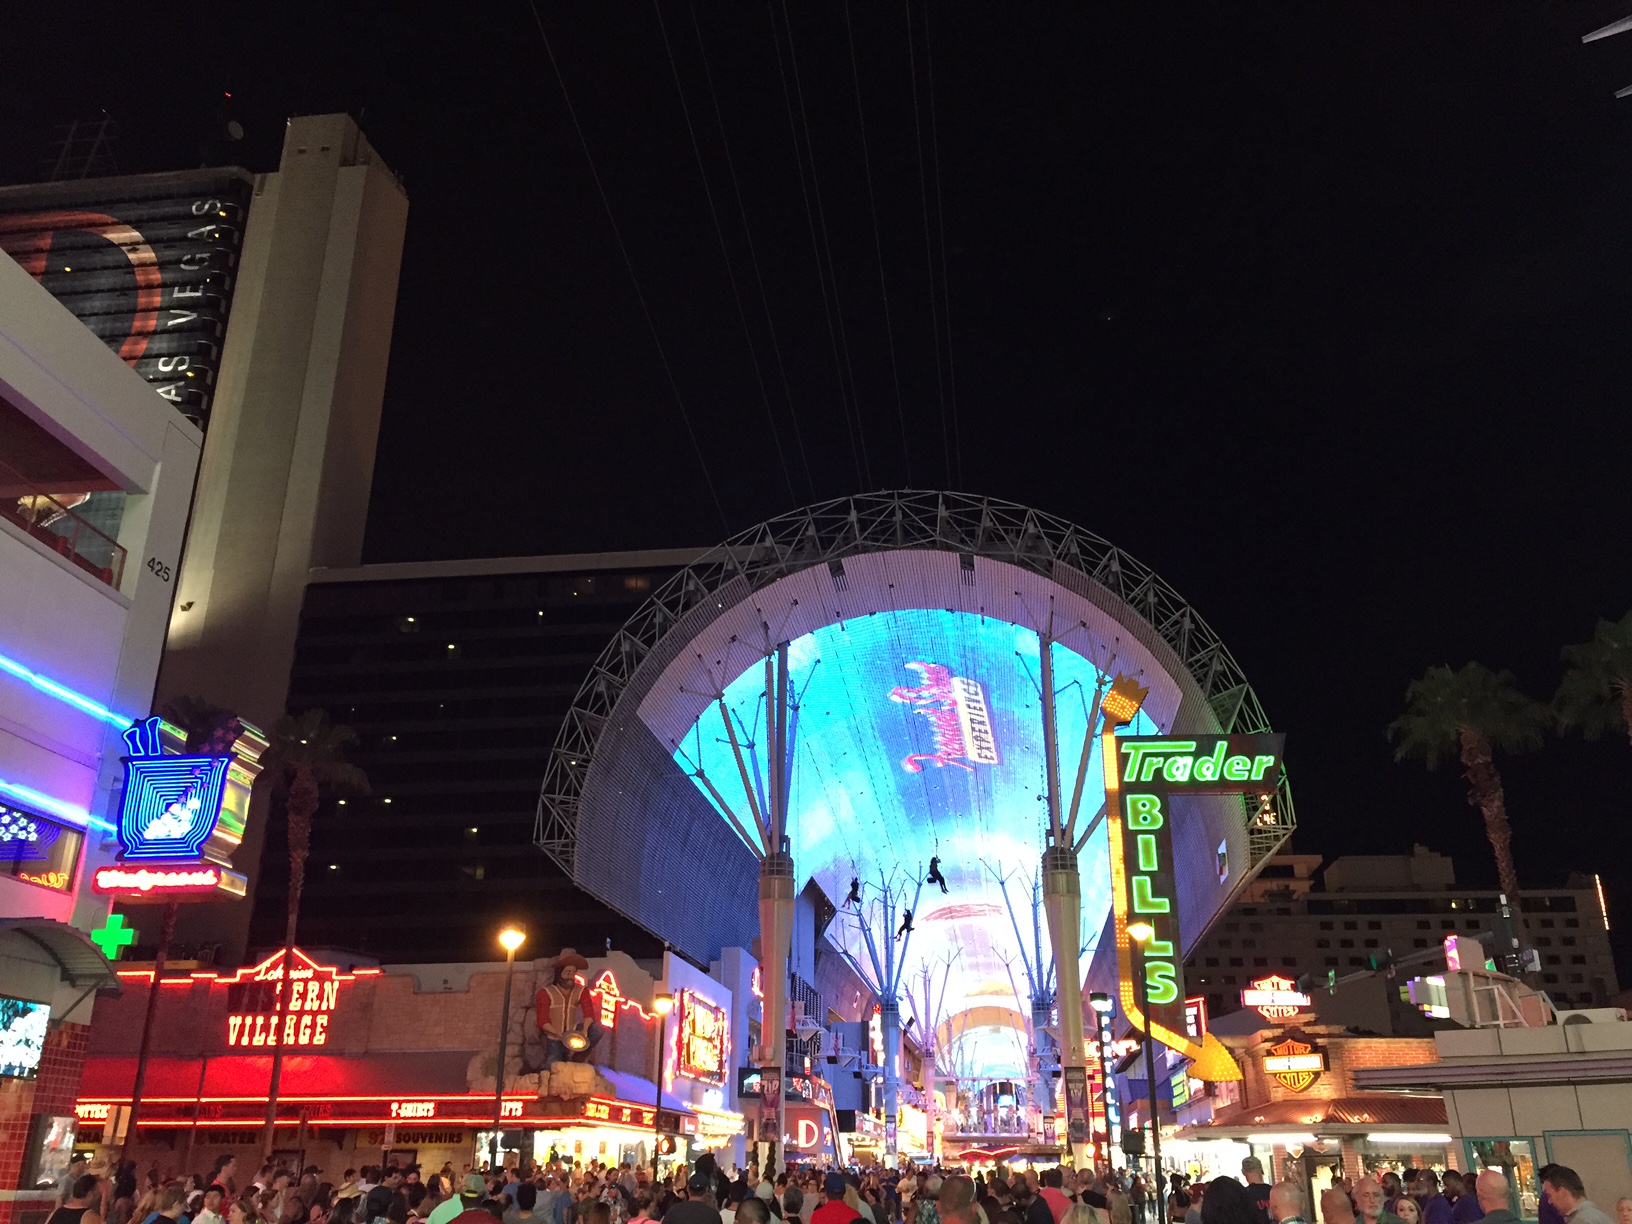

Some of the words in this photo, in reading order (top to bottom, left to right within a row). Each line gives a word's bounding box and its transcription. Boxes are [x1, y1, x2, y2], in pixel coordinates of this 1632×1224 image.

[166, 199, 222, 327] VEGAS
[155, 355, 190, 402] AS
[147, 556, 171, 582] 425
[1121, 740, 1275, 782] Trader
[1126, 794, 1179, 1004] BILLS
[228, 1014, 328, 1046] VILLAGE
[1275, 1043, 1308, 1055] MOTOR
[1279, 1072, 1310, 1089] CYCLES
[391, 1102, 435, 1118] T-SHIRTS
[501, 1101, 523, 1117] IFTS
[208, 1131, 256, 1145] WATER
[395, 1132, 463, 1144] SOUVENIRS
[797, 1119, 819, 1149] D
